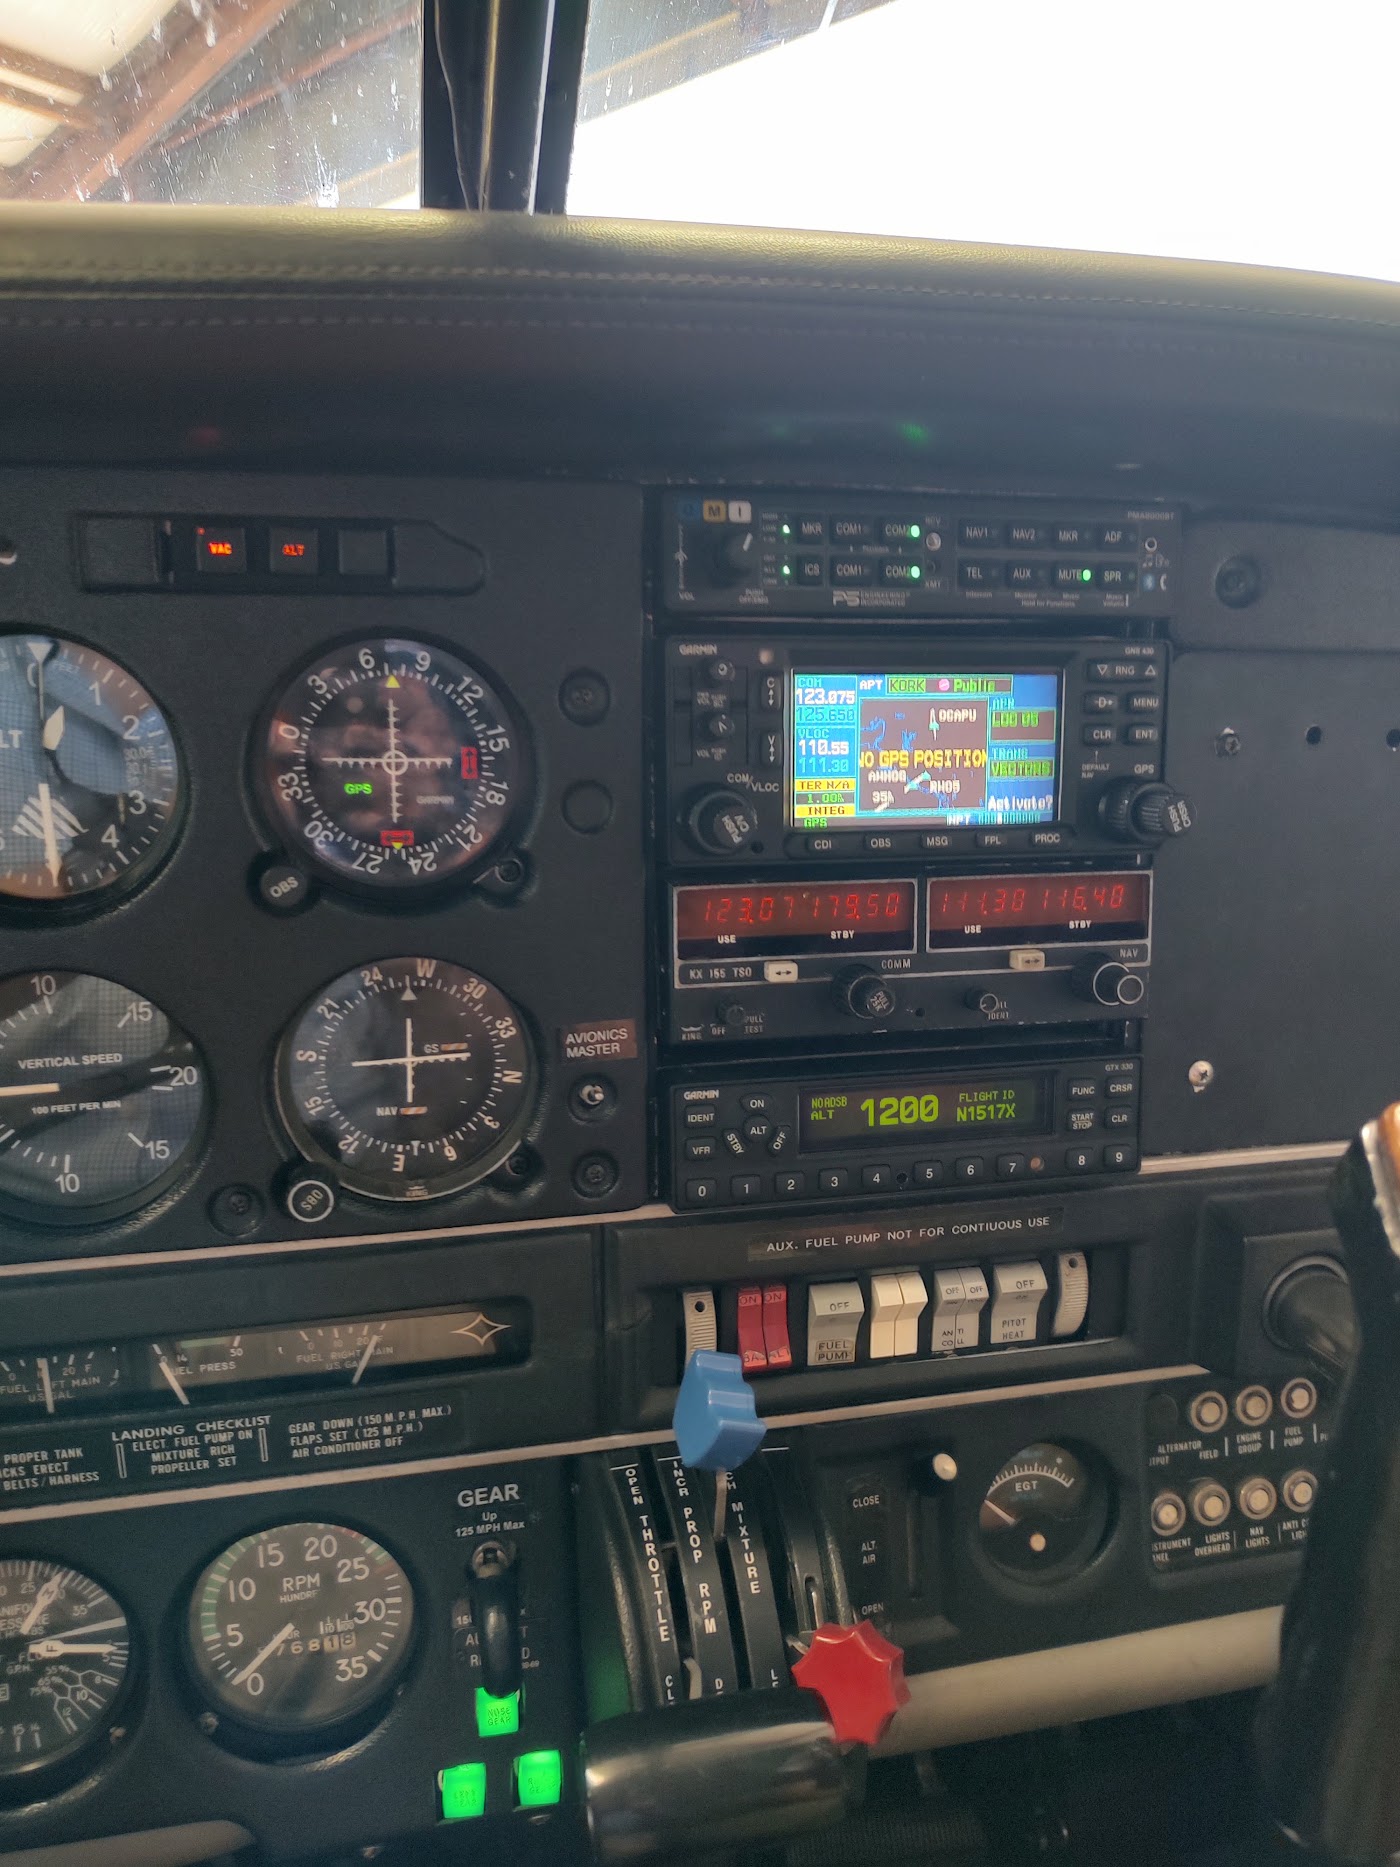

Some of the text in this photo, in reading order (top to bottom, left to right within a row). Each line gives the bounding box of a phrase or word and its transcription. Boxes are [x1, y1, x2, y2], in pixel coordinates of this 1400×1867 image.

[802, 524, 822, 534] MKR
[837, 524, 862, 534] COM1
[966, 527, 988, 537] NAV1
[1013, 529, 1035, 540] NAV2
[1059, 531, 1078, 541] MKR
[1105, 532, 1122, 541] ADF
[805, 564, 819, 575] ICS
[837, 565, 862, 575] COM1
[966, 567, 982, 578] TEL
[1013, 568, 1031, 578] AUX
[1058, 569, 1082, 579] MUTE
[1104, 571, 1121, 581] SPR
[679, 644, 717, 655] GARMIN
[1116, 666, 1134, 675] RNG
[798, 678, 821, 687] COM
[860, 680, 882, 689] APT
[796, 689, 855, 705] 123.075
[1134, 698, 1158, 707] MENU
[797, 707, 854, 722] 125.650
[800, 728, 829, 739] VLOC
[1093, 731, 1111, 739] CLR
[1136, 730, 1154, 738] ENT
[799, 740, 849, 756] 110.55
[879, 751, 909, 767] GPS
[914, 750, 987, 768] POSITION
[800, 759, 848, 773] 111.30
[1135, 765, 1154, 774] GPS
[344, 784, 372, 794] GPS
[800, 781, 849, 790] TER N/A
[808, 806, 845, 815] INTEG
[804, 817, 827, 828] GPS
[871, 838, 891, 848] OBS
[927, 837, 948, 846] MSG
[985, 836, 1000, 844] FPL
[1035, 833, 1060, 843] PROC
[815, 840, 831, 849] CDI
[270, 877, 299, 898] OBS
[964, 925, 981, 933] USE
[1069, 920, 1091, 929] STBY
[718, 935, 736, 944] USE
[831, 930, 854, 939] STBY
[1120, 949, 1138, 958] NAV
[881, 959, 911, 969] COMM
[689, 969, 702, 979] KX
[733, 967, 752, 977] TSO
[712, 1027, 726, 1035] OFF
[566, 1028, 628, 1045] AVIONICS
[567, 1043, 620, 1058] MASTER
[18, 1053, 123, 1069] VERTICAL SPEED
[1072, 1087, 1095, 1095] FUNC
[1110, 1084, 1132, 1092] CRSR
[684, 1090, 719, 1100] GARMIN
[959, 1090, 1014, 1102] FLIGHT ID
[32, 1100, 121, 1115] 100 FEET PER MIN
[750, 1100, 764, 1108] ON
[376, 1107, 398, 1116] NAV
[811, 1110, 834, 1120] ALT
[860, 1094, 938, 1127] 1200
[957, 1104, 1015, 1122] N1517X
[688, 1114, 714, 1122] IDENT
[1071, 1113, 1093, 1121] START
[1073, 1121, 1092, 1129] STOP
[727, 1134, 744, 1155] STBY
[773, 1132, 787, 1150] OFF
[693, 1146, 710, 1155] VFR
[301, 1189, 323, 1211] OBS
[766, 1216, 1050, 1253] AUX. FUEL PUMP NOT FOR CONTIUOUS USE
[1016, 1280, 1035, 1289] OFF
[1002, 1318, 1026, 1328] PITOT
[1002, 1331, 1024, 1340] HEAT
[818, 1341, 848, 1350] FUEL
[1, 1377, 100, 1394] FUEL LFT MAIN
[111, 1415, 271, 1441] LANDING CHECKLIST
[289, 1422, 315, 1434] GEAR
[323, 1419, 354, 1430] DOWN
[1285, 1427, 1302, 1435] FUEL
[175, 1436, 200, 1447] FUEL
[205, 1433, 234, 1444] PUMP
[238, 1431, 253, 1440] ON
[290, 1433, 323, 1447] FLAPS
[330, 1431, 347, 1442] SET
[1236, 1433, 1262, 1442] ENGINE
[1284, 1437, 1304, 1446] PUMP
[292, 1436, 403, 1459] AIR CONDITIONER OFF
[1158, 1441, 1202, 1454] ALTERNATOR
[1238, 1444, 1262, 1454] GROUP
[4, 1448, 84, 1464] PROPER TANK
[152, 1445, 235, 1462] MIXTURE RICH
[1199, 1450, 1219, 1460] FIELD
[151, 1456, 237, 1474] PROPELLER SET
[1015, 1481, 1038, 1492] EGT
[457, 1483, 520, 1507] GEAR
[853, 1495, 880, 1508] CLOSE
[482, 1512, 497, 1522] Up
[455, 1521, 525, 1537] 125 MPH Max
[1282, 1520, 1299, 1529] ANTI
[1250, 1527, 1264, 1536] NAV
[1205, 1533, 1230, 1543] LIGHTS
[1246, 1537, 1270, 1548] LIGHTS
[304, 1535, 337, 1561] 20
[673, 1460, 717, 1634] INCR PROP RPM
[732, 1502, 761, 1594] MIXTURE
[1195, 1544, 1230, 1556] OVERHEAD
[258, 1543, 284, 1568] 15
[625, 1469, 670, 1642] OPEN THROTTLE
[862, 1554, 876, 1564] AIR
[337, 1557, 370, 1583] 25
[282, 1573, 320, 1592] RPM
[229, 1578, 256, 1602] 10
[354, 1598, 386, 1624] 30
[861, 1602, 884, 1615] OPEN
[336, 1656, 368, 1681] 35
